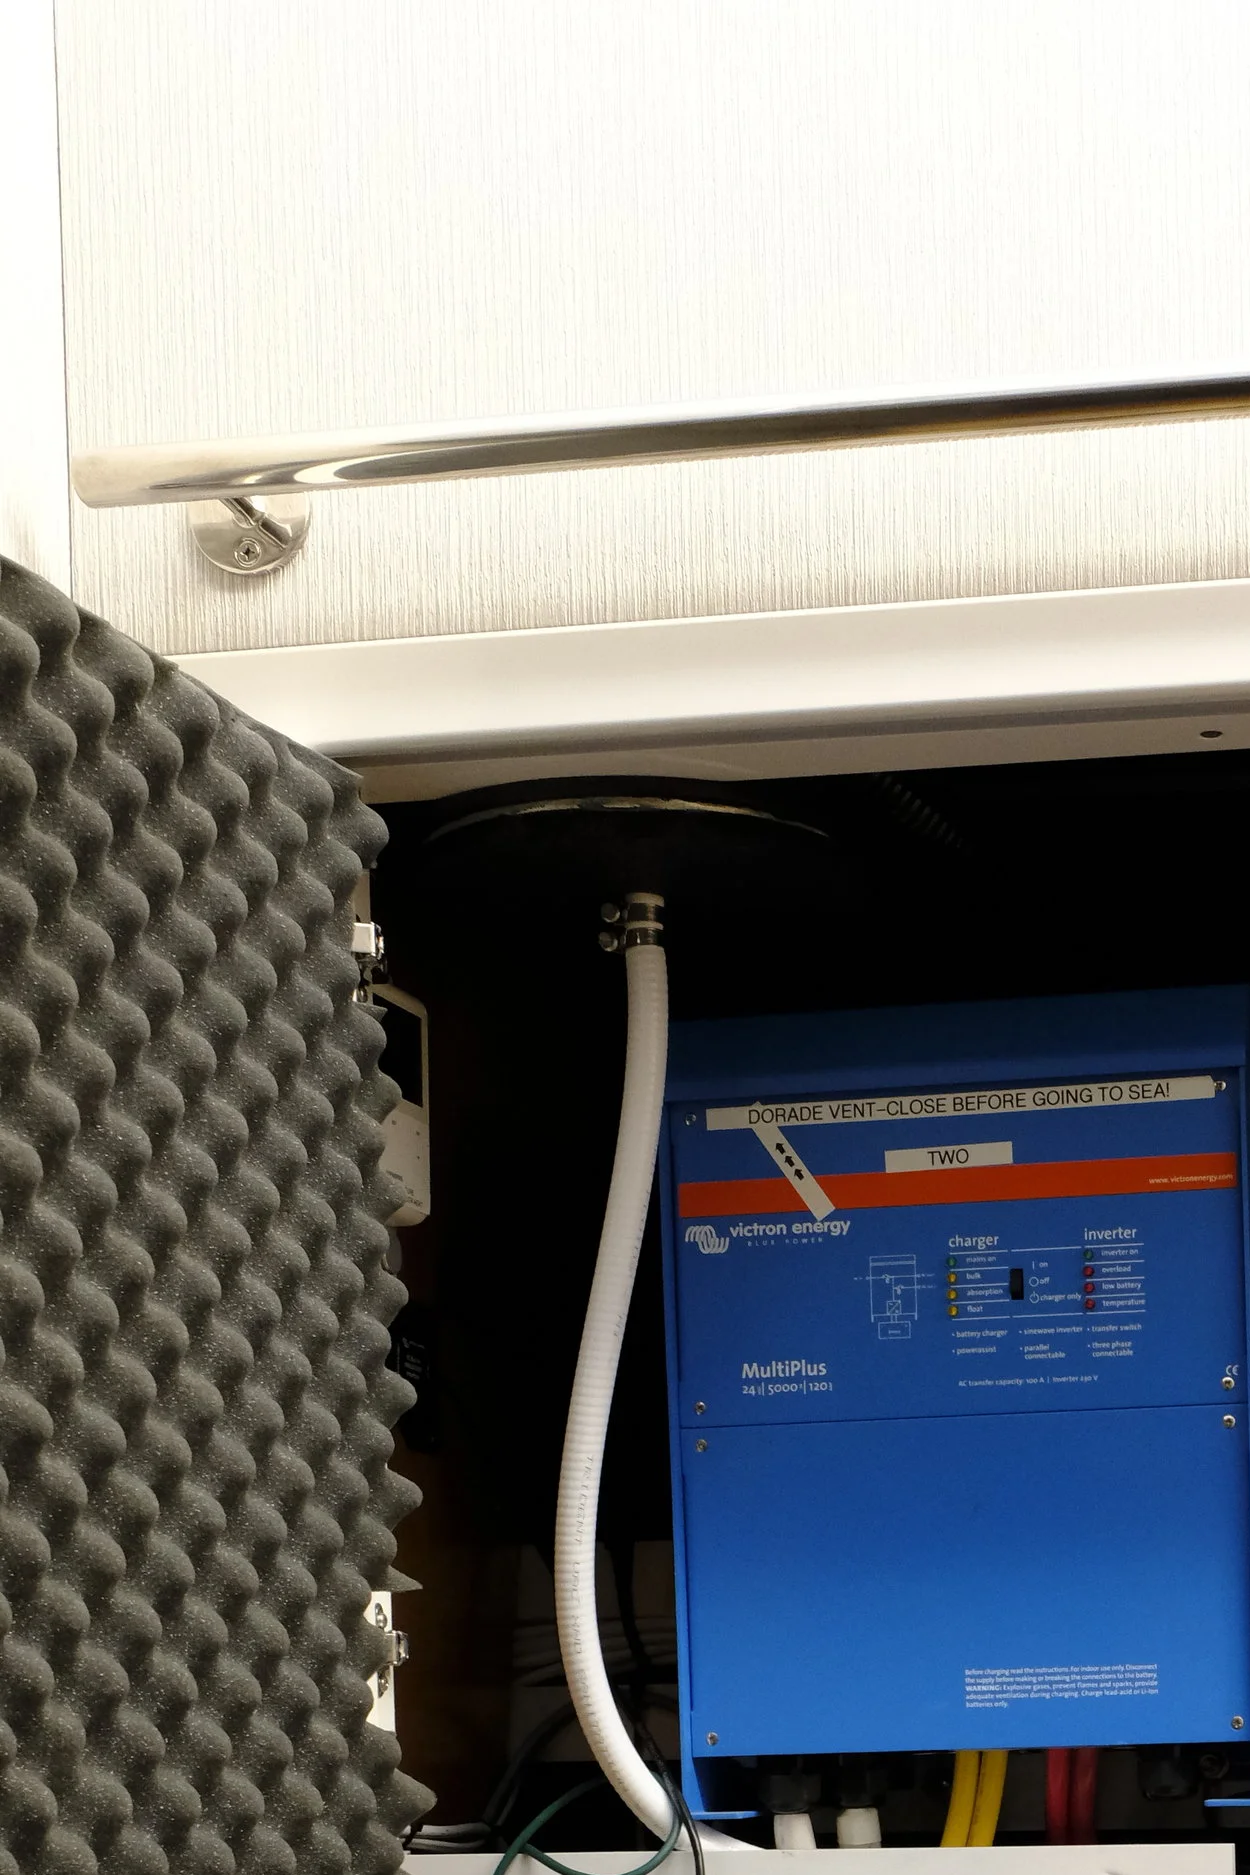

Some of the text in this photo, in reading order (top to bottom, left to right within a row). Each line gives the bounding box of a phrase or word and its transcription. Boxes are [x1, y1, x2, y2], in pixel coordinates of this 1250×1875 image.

[749, 1083, 1170, 1124] DORADE VENT-CLOSE BEFORE GOING TO SEA!
[928, 1148, 969, 1166] TWO
[730, 1220, 850, 1238] victron energy
[1084, 1227, 1137, 1241] inverter
[948, 1234, 999, 1250] charger
[1101, 1248, 1126, 1257] inverter
[1102, 1282, 1142, 1291] low battery
[742, 1359, 827, 1379] MultiPlus
